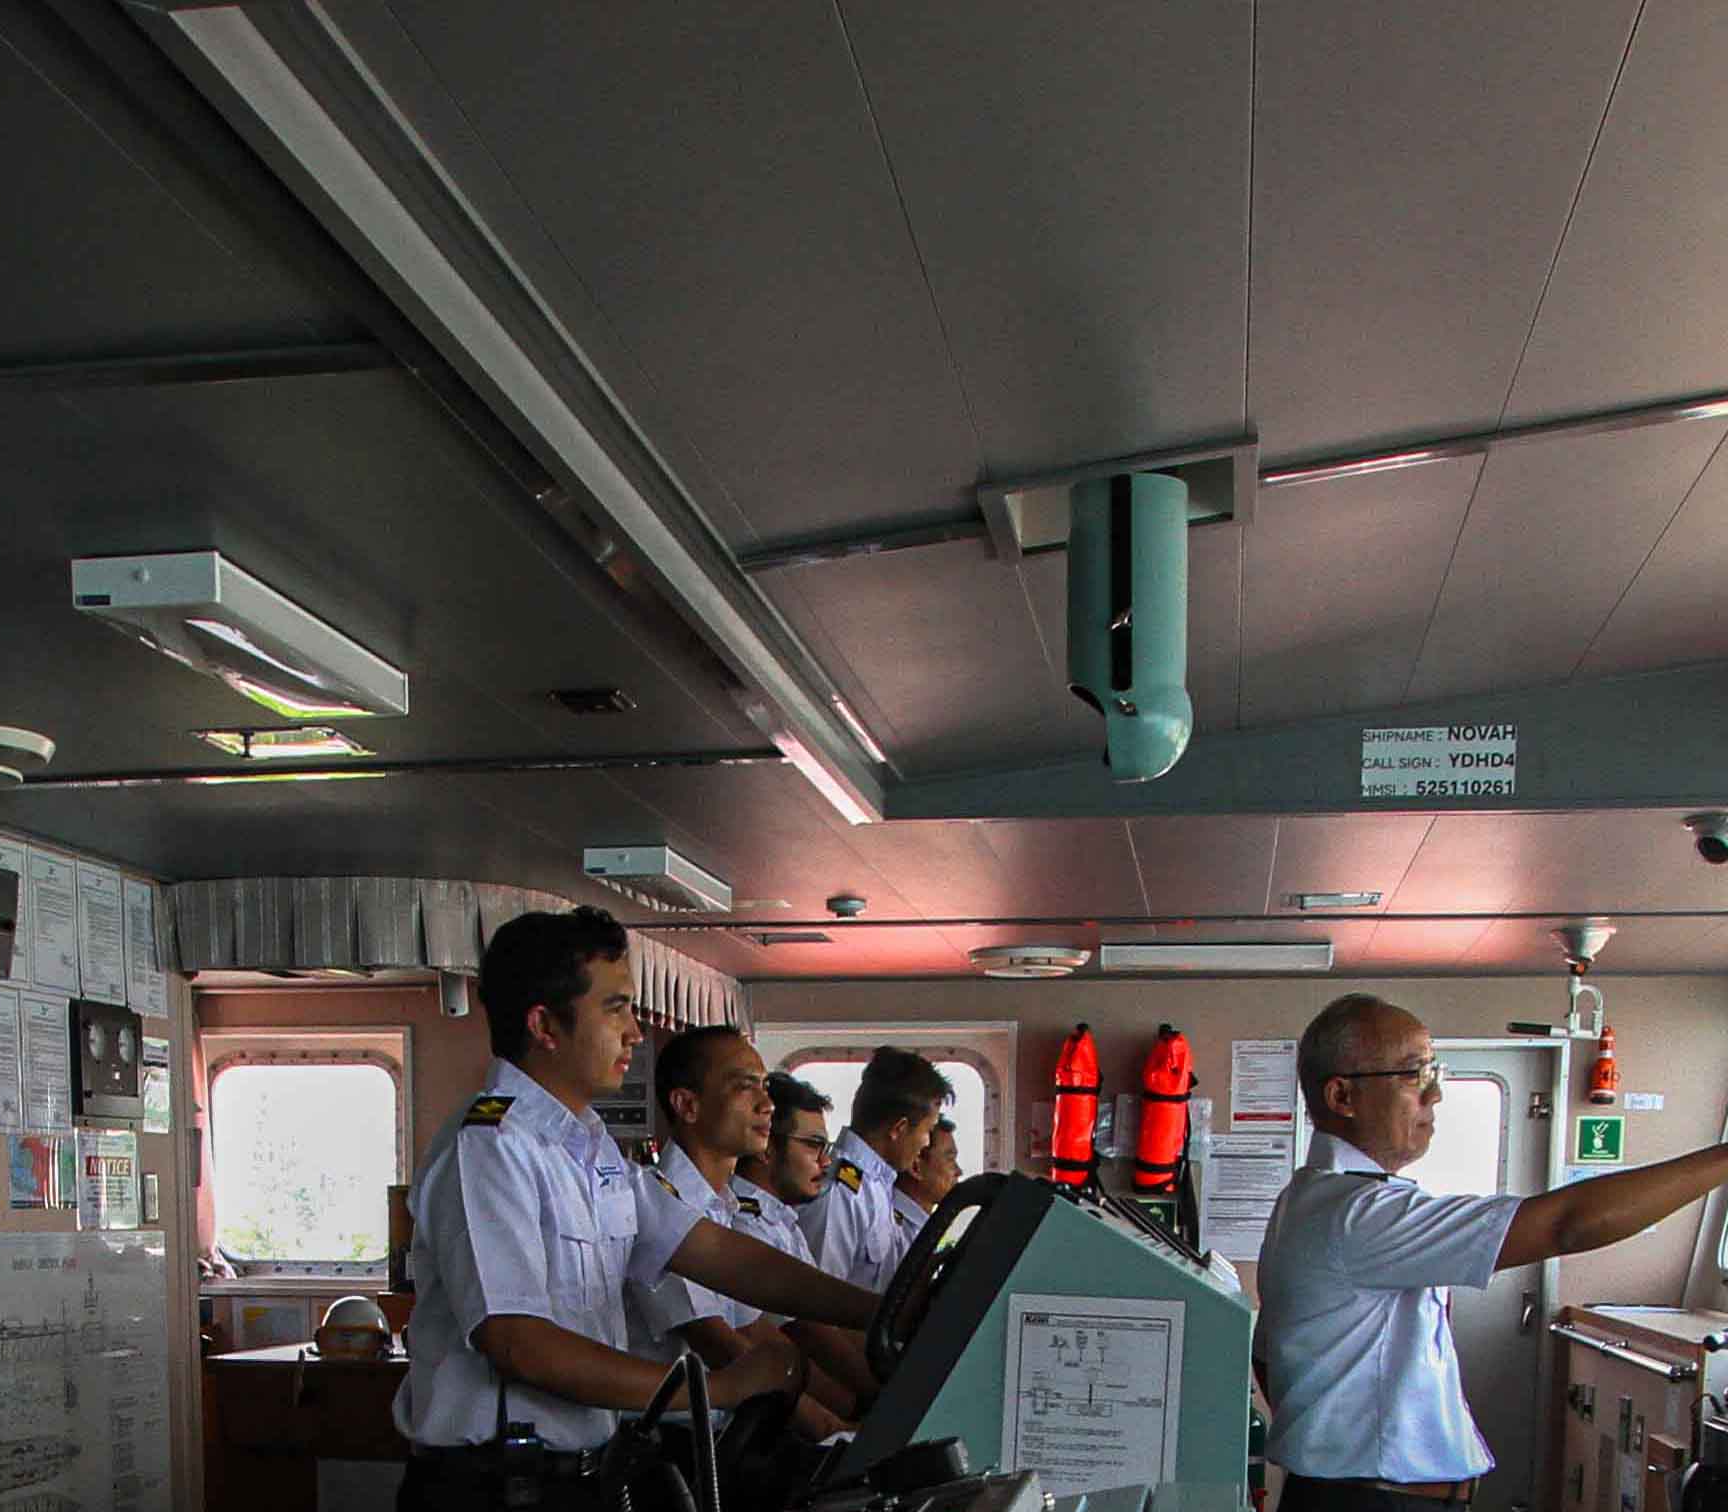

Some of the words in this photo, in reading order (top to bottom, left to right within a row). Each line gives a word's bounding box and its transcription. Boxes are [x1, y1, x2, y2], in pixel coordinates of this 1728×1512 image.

[1362, 730, 1433, 743] SHIPNAME
[1362, 757, 1394, 769] CALL
[1448, 752, 1515, 768] YDHD4
[1416, 780, 1513, 795] 525110261
[88, 1158, 130, 1176] NOTICE
